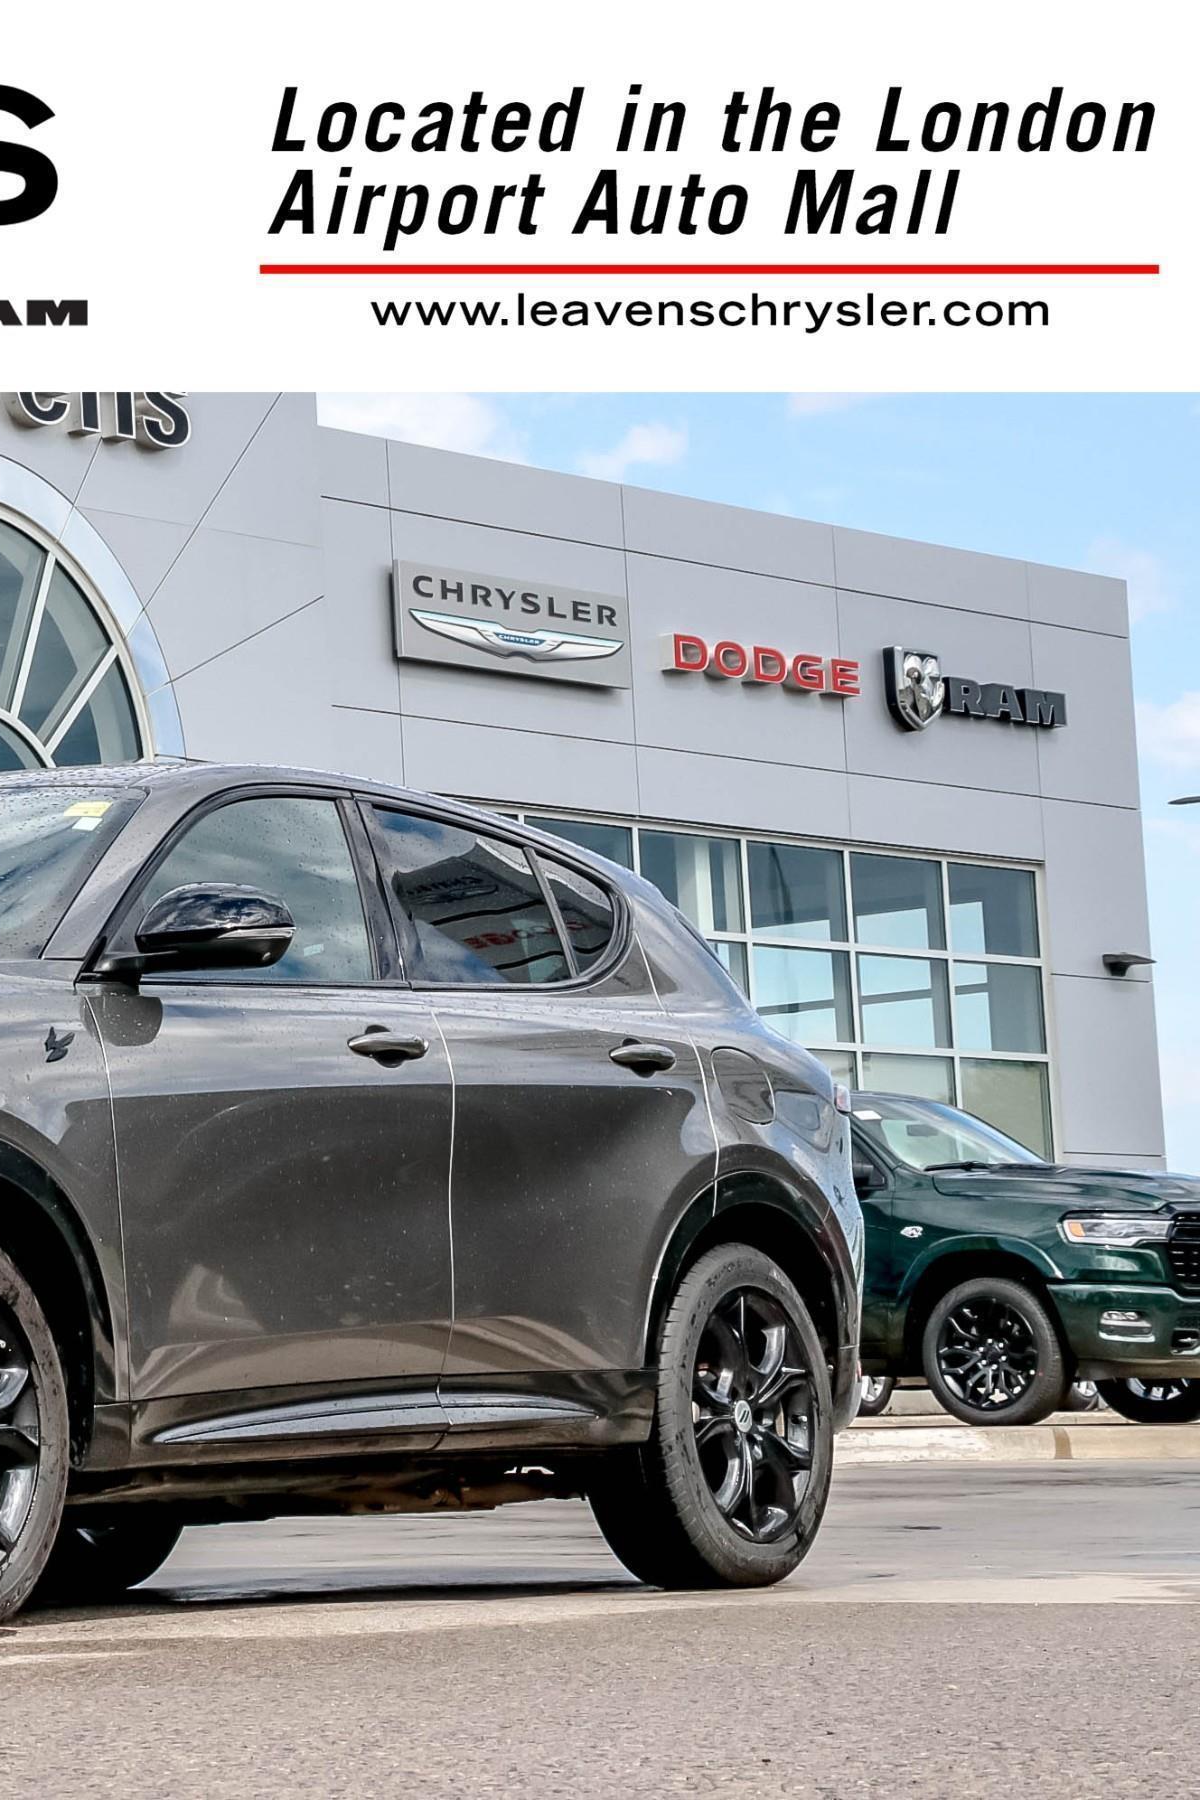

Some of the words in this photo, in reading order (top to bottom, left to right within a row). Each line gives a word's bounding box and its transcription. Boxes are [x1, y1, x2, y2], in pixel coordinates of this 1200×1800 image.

[412, 575, 617, 627] CHRYSLER
[672, 633, 861, 696] DODGE
[942, 676, 1067, 727] RAM
